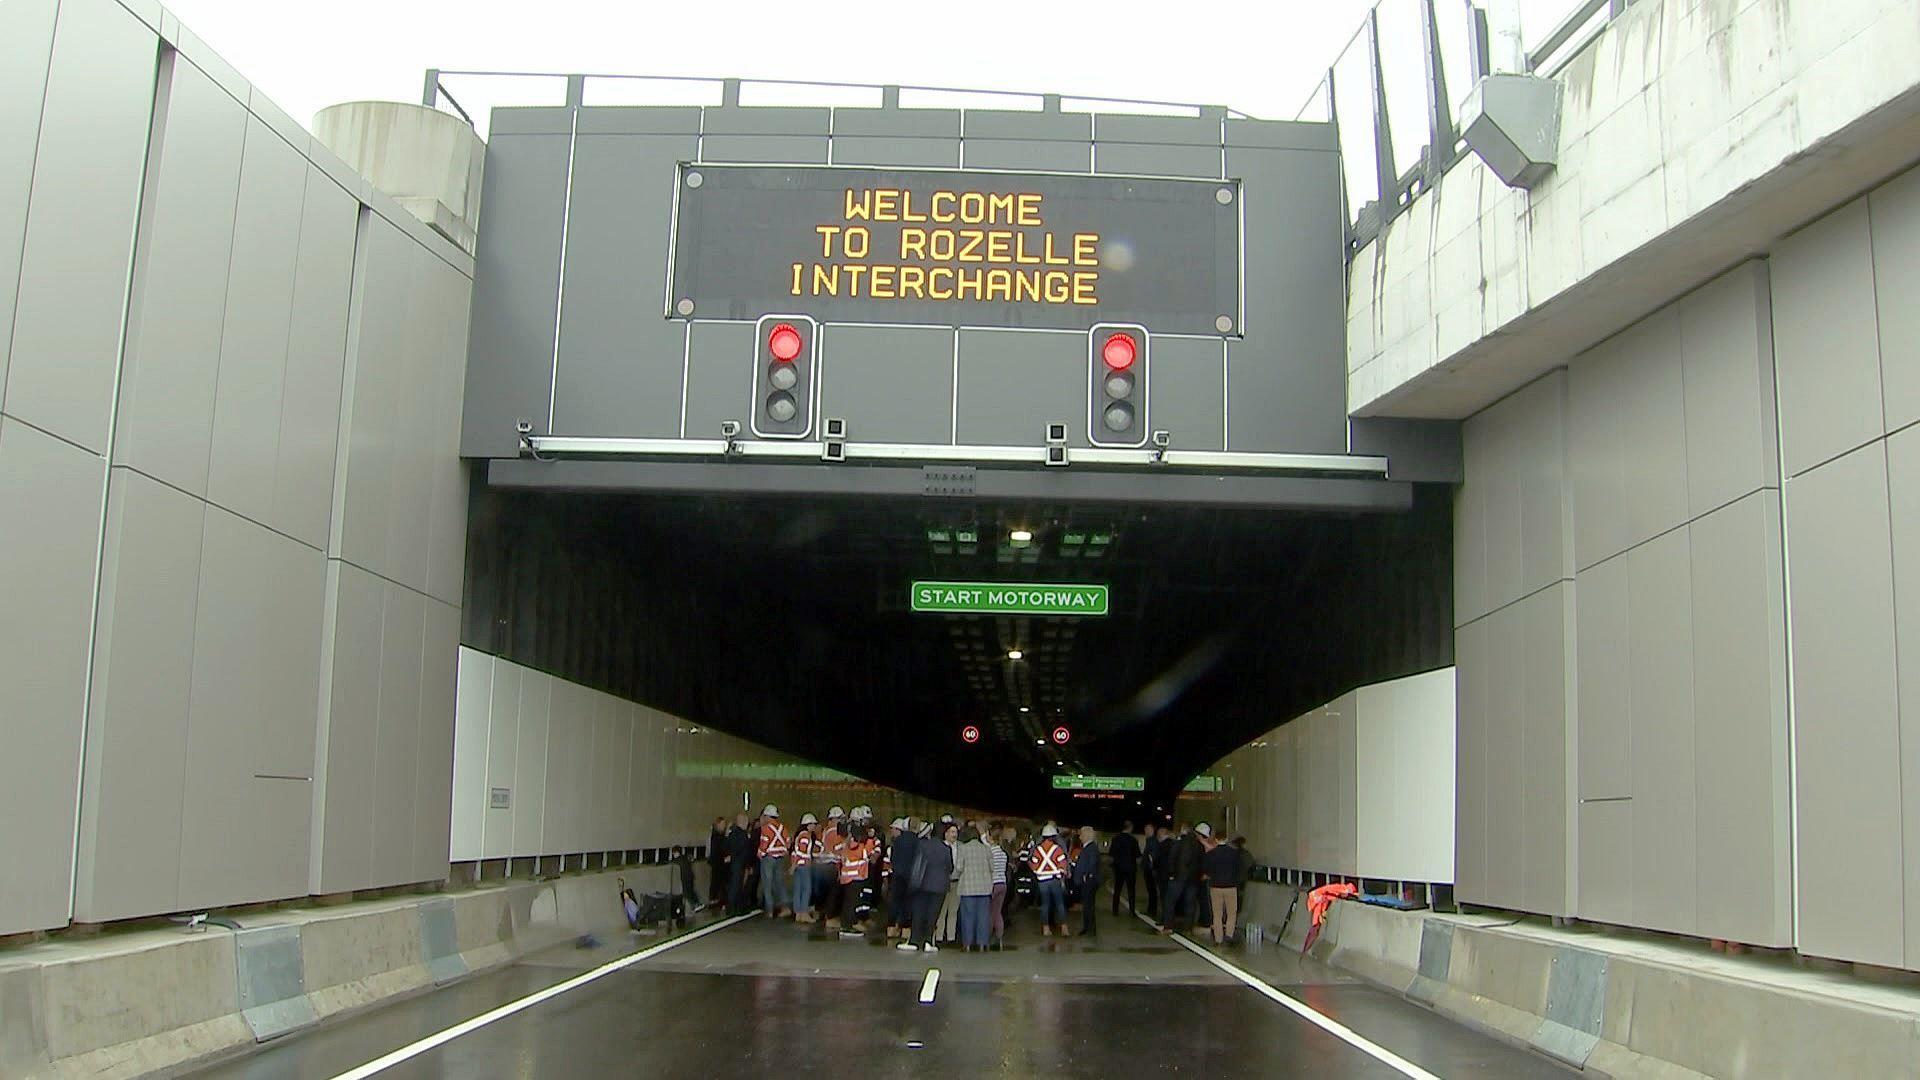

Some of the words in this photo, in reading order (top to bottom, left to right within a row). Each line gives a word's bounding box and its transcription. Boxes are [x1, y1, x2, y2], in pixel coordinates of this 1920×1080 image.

[845, 189, 1043, 226] WELCOME
[816, 225, 871, 259] TO
[900, 226, 1099, 266] ROZELLE
[791, 263, 1098, 305] INTERCHANGE
[919, 589, 983, 605] START
[988, 590, 1100, 607] MOTORWAY
[965, 730, 976, 739] 60
[1056, 731, 1067, 740] 60
